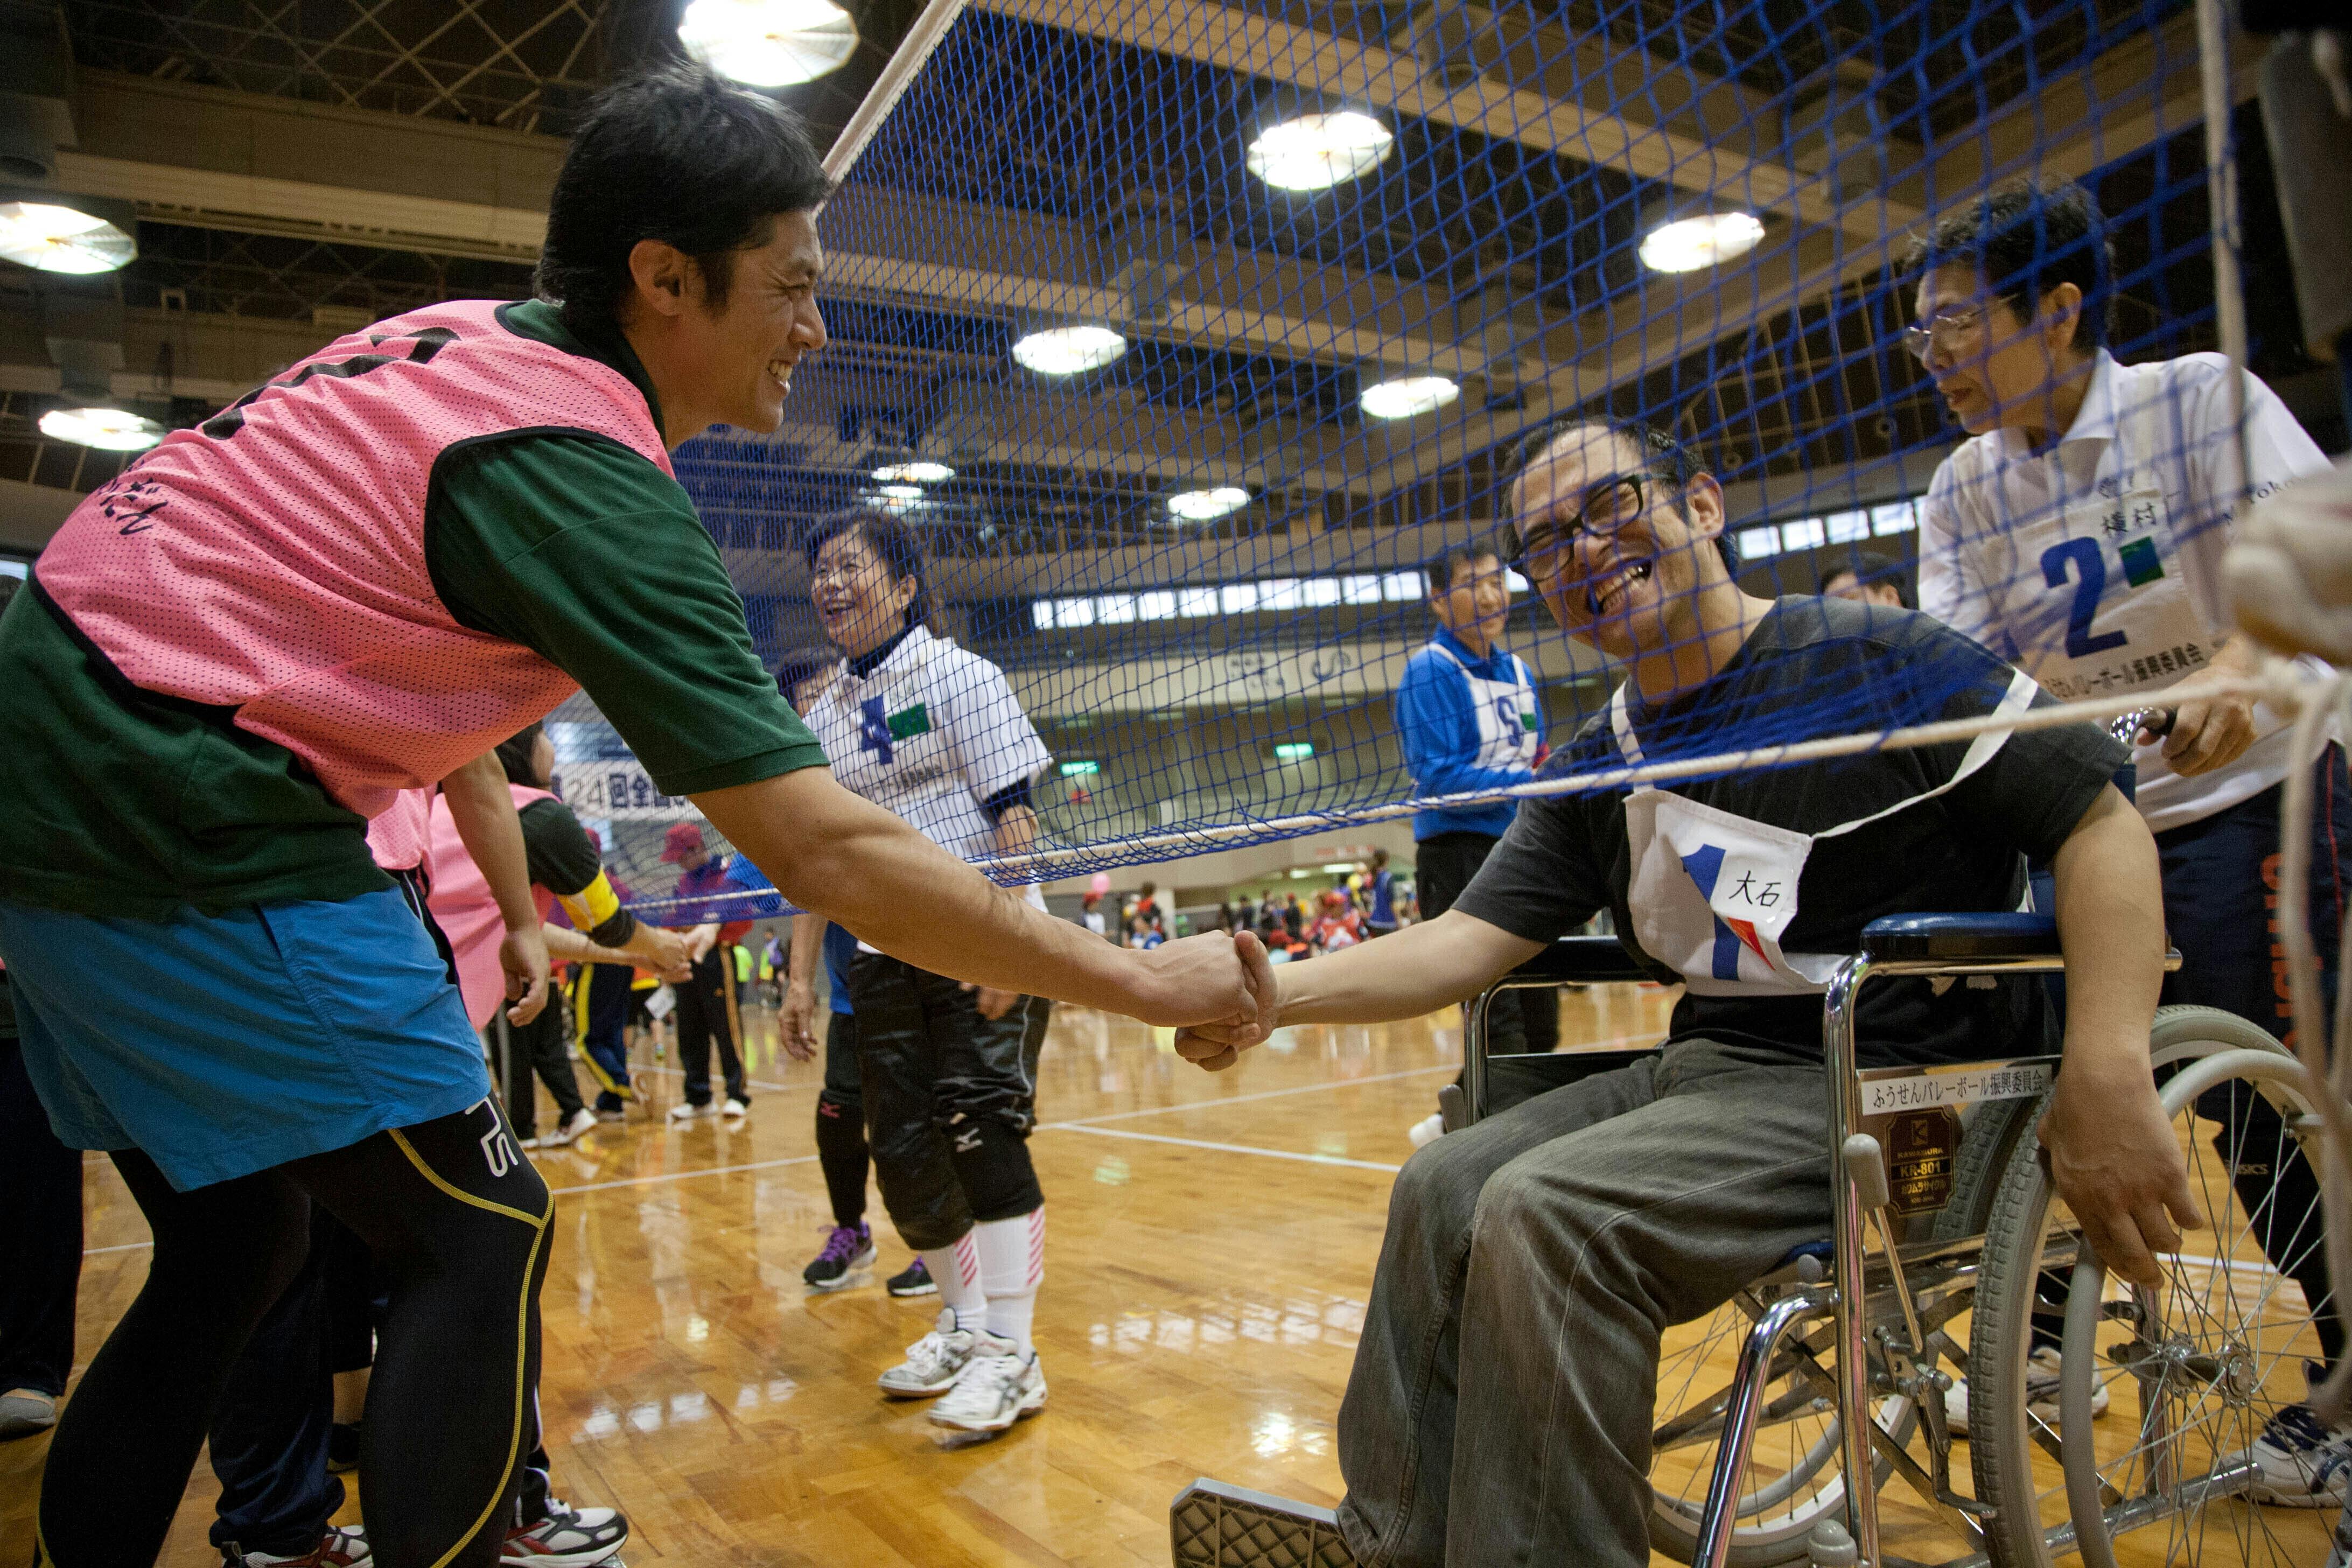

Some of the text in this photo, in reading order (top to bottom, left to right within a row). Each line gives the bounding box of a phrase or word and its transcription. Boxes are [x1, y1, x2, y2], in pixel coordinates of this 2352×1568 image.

[2040, 536, 2128, 659] 2
[1728, 870, 1781, 907] 大石
[1681, 844, 1741, 982] 1
[1873, 1070, 2043, 1108] ふうせんバレーボール振興委員会
[1900, 1162, 1941, 1178] KR-801
